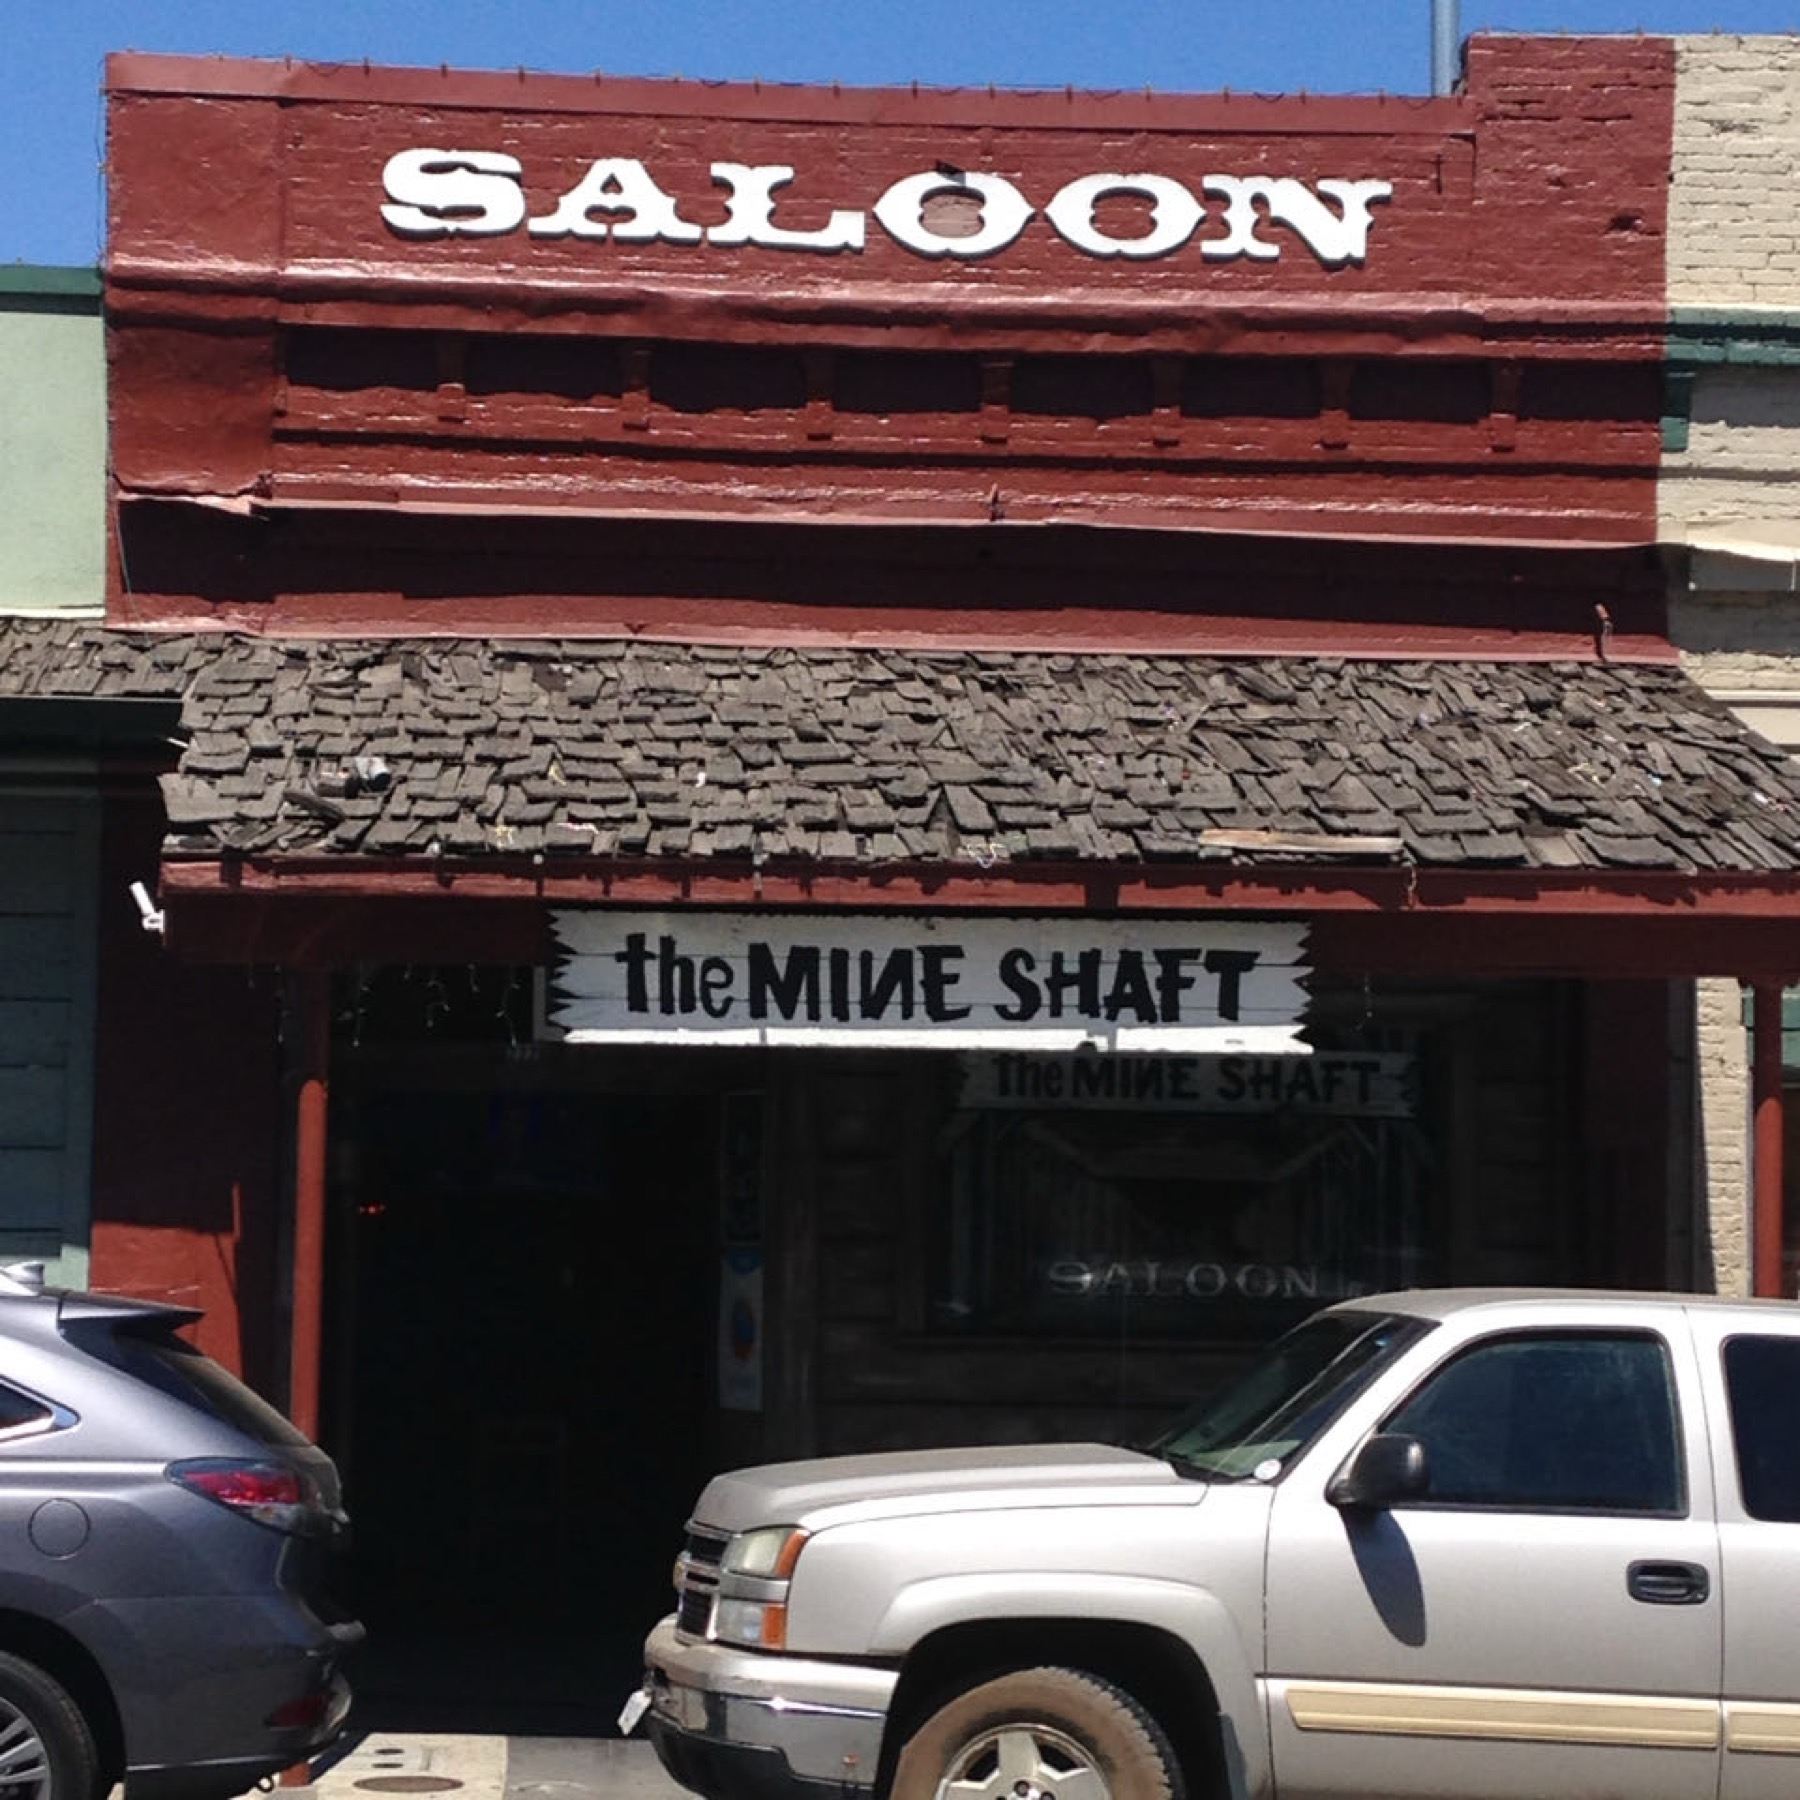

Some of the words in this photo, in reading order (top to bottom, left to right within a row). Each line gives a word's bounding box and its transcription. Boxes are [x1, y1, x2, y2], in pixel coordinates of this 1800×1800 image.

[380, 147, 1393, 266] SALOON
[616, 932, 733, 1018] the
[748, 942, 972, 1022] MINE
[994, 946, 1260, 1022] SHAFT
[1072, 1056, 1199, 1100] MINE
[1217, 1057, 1381, 1103] SHAFT
[1048, 1260, 1318, 1299] SALOON
